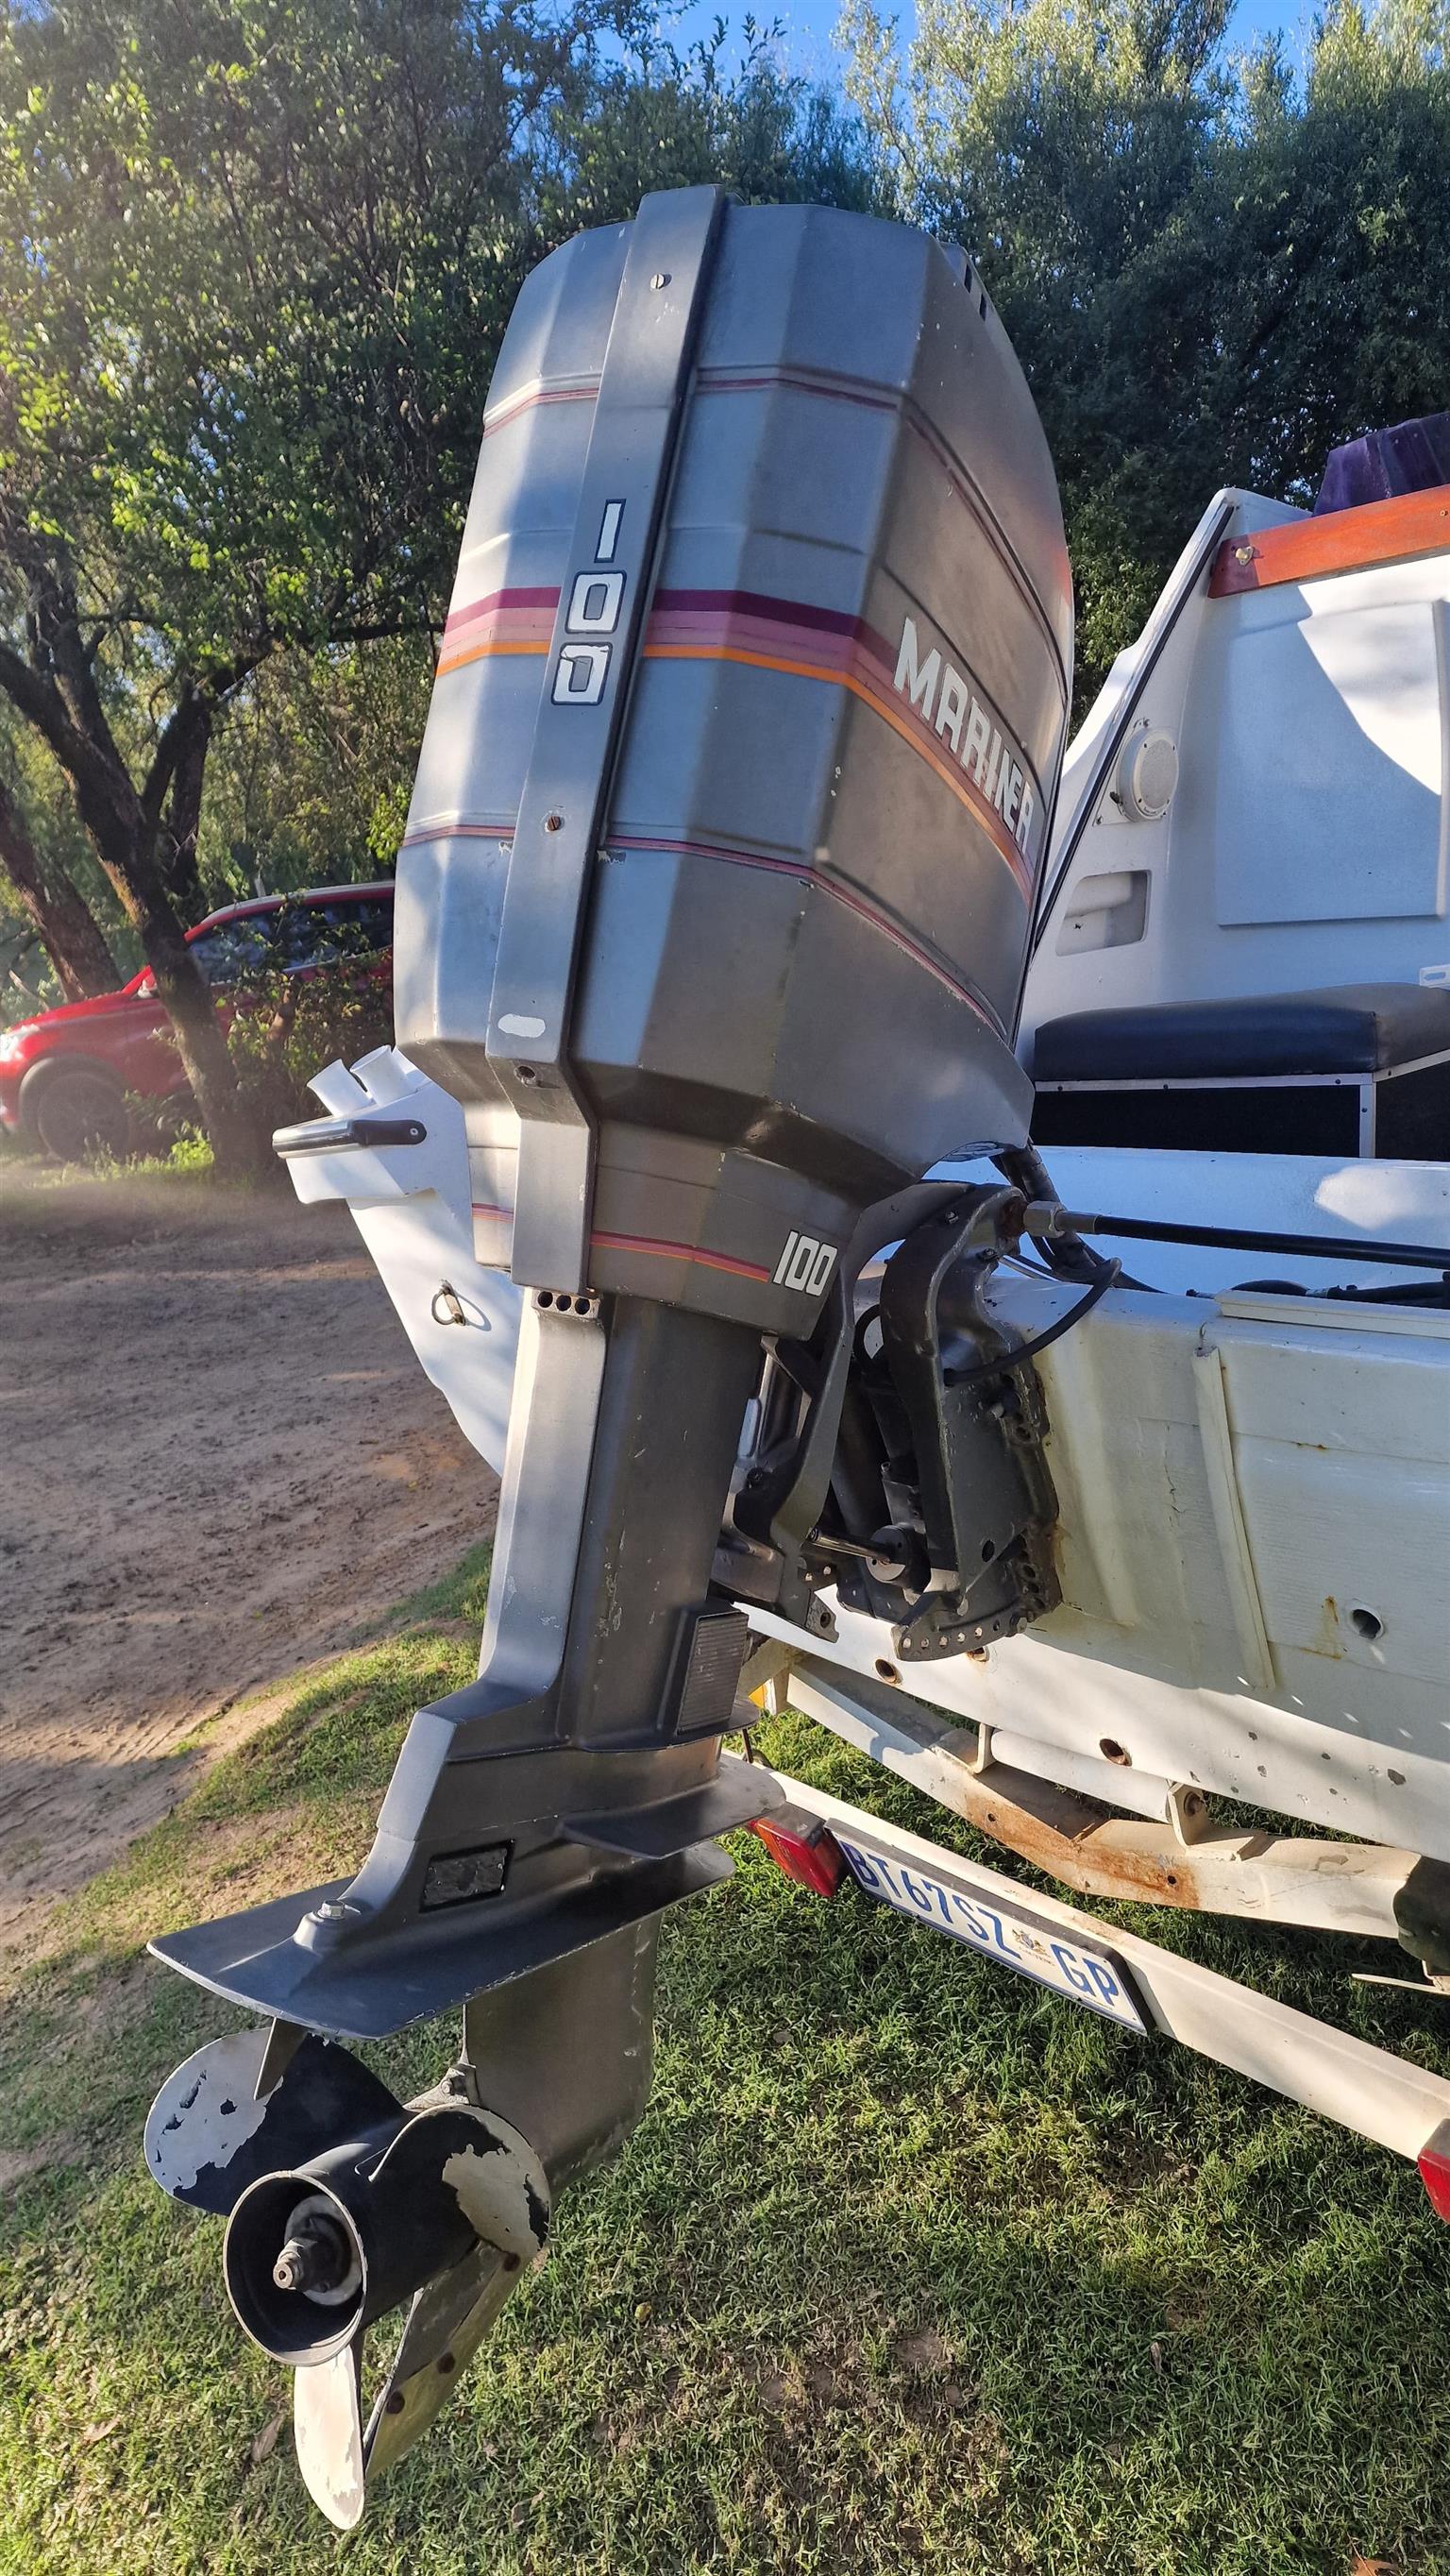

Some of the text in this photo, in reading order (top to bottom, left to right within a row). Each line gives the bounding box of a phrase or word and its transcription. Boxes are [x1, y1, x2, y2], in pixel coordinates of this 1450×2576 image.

[551, 499, 627, 705] 100
[893, 617, 1034, 856] MARINER
[773, 1229, 838, 1297] 100
[1050, 1943, 1119, 2007] GP
